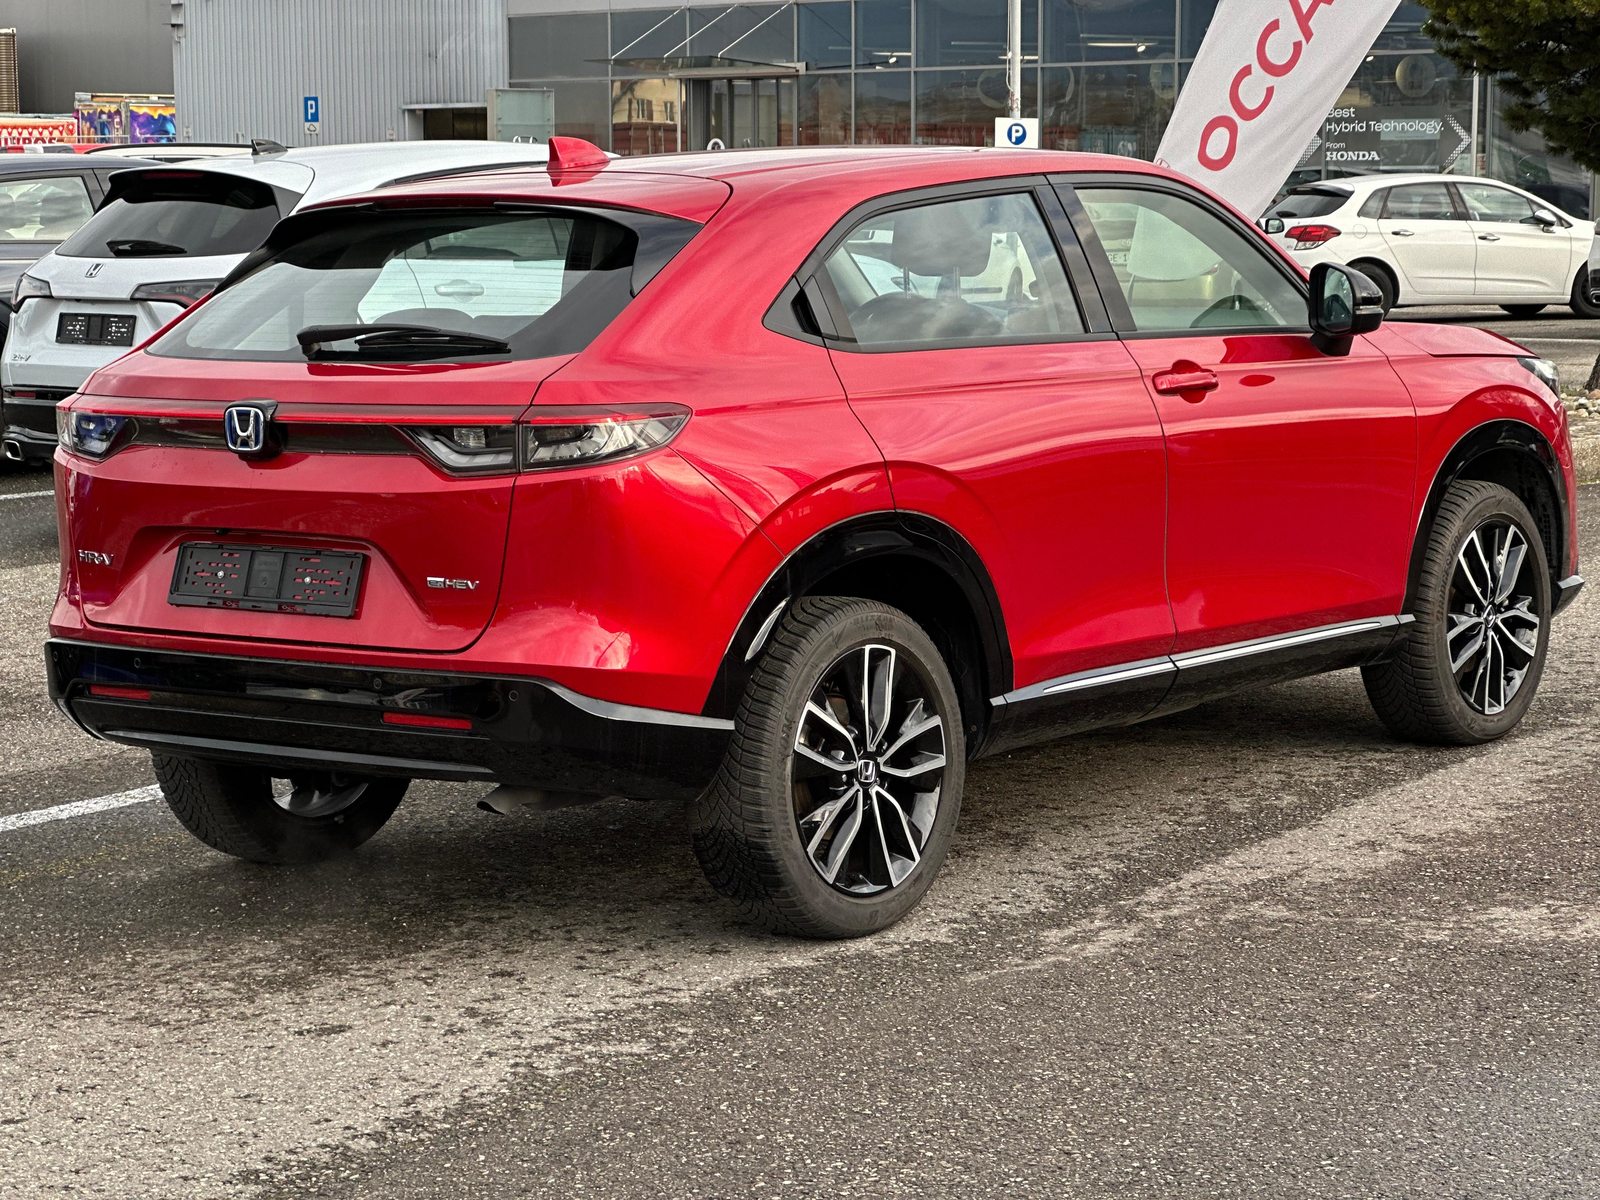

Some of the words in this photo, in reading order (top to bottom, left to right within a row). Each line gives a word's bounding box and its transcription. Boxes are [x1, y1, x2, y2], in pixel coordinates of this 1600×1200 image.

[307, 100, 316, 120] P
[1327, 107, 1355, 118] Best
[1011, 125, 1024, 143] P
[1326, 121, 1366, 135] Hybrid
[1369, 120, 1444, 134] Technology.
[1325, 151, 1380, 161] HONDA
